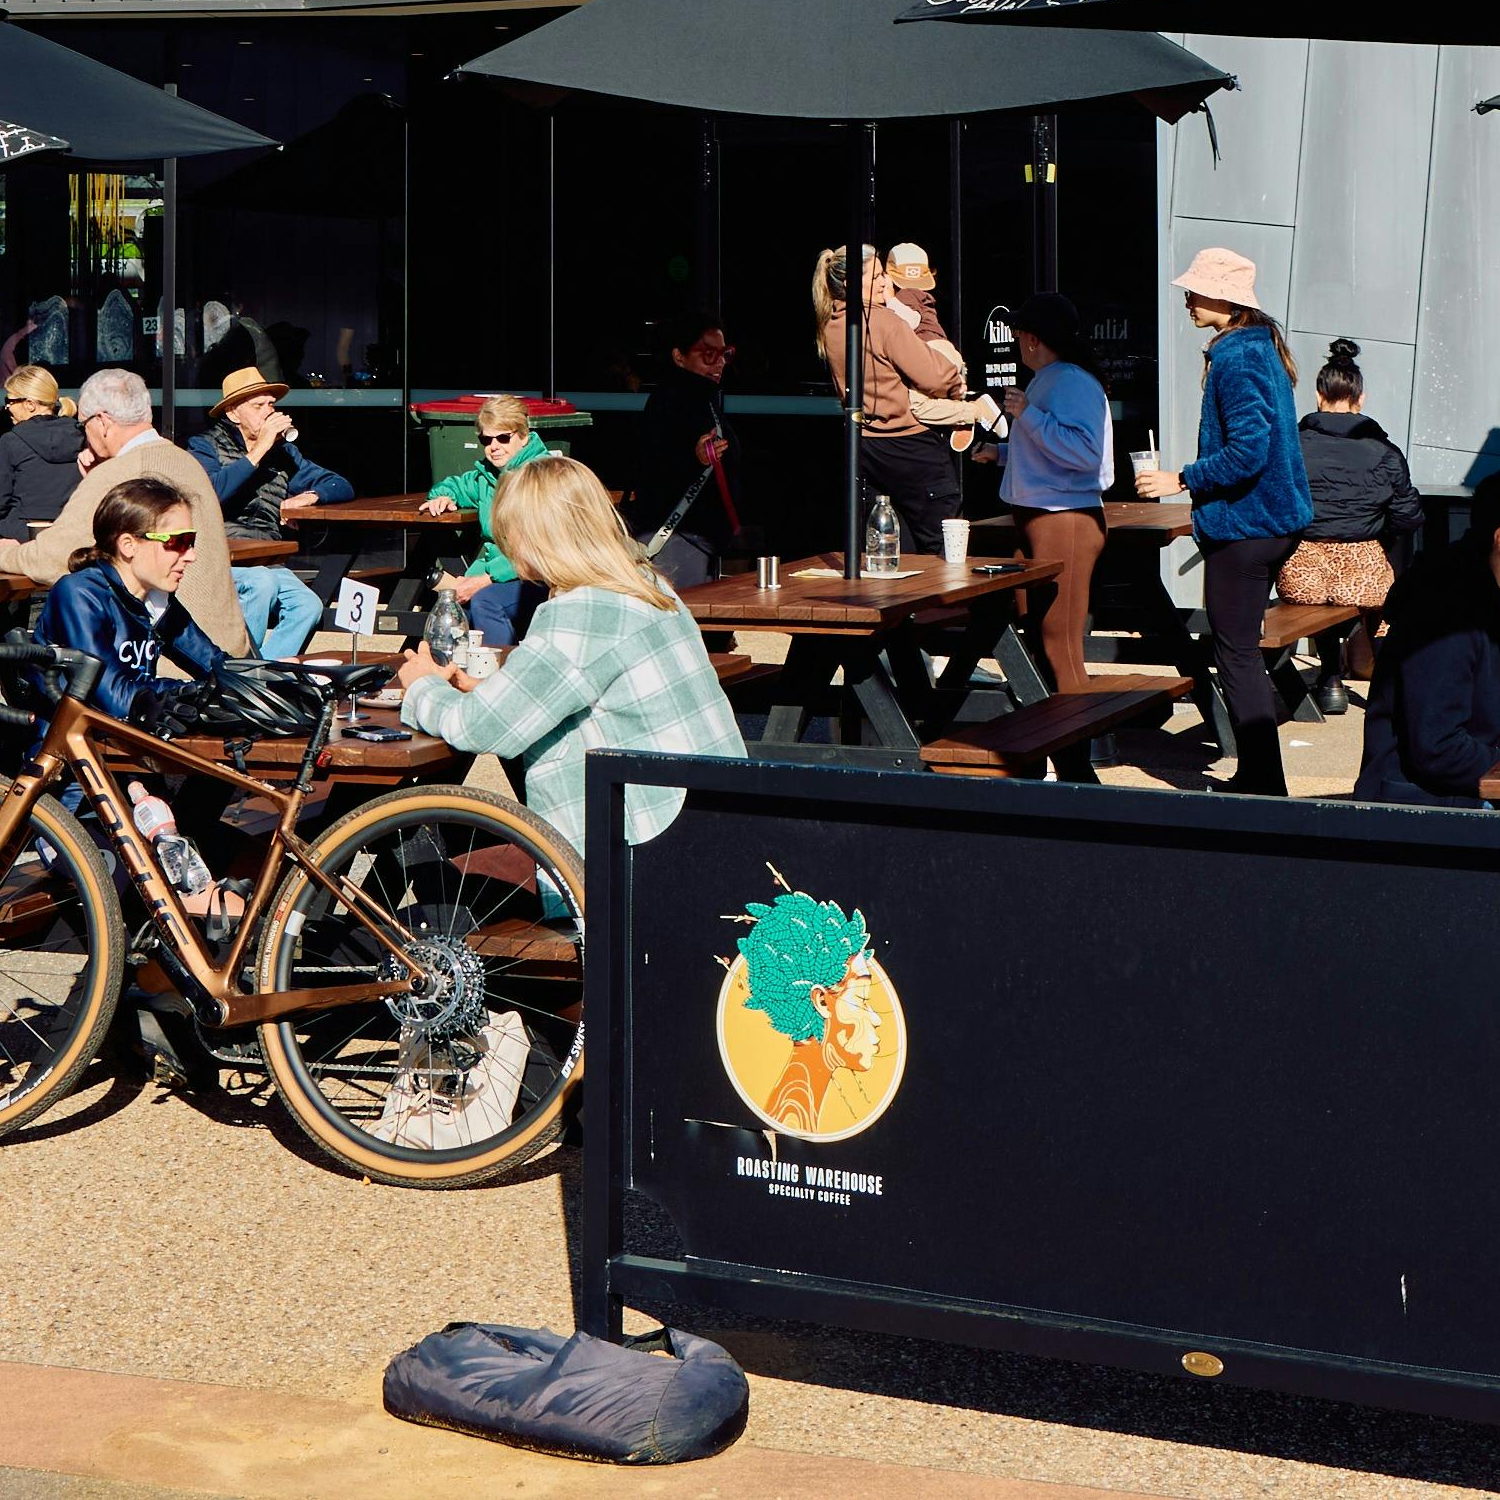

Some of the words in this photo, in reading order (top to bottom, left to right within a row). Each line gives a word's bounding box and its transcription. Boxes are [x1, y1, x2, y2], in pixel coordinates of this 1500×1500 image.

[144, 318, 159, 333] 23
[350, 591, 364, 623] 3
[561, 1055, 576, 1079] DT
[736, 1156, 800, 1183] ROASTING
[805, 1165, 883, 1196] WAREHOUSE
[768, 1183, 815, 1200] SPECIALTY
[817, 1190, 851, 1206] COFFEE
